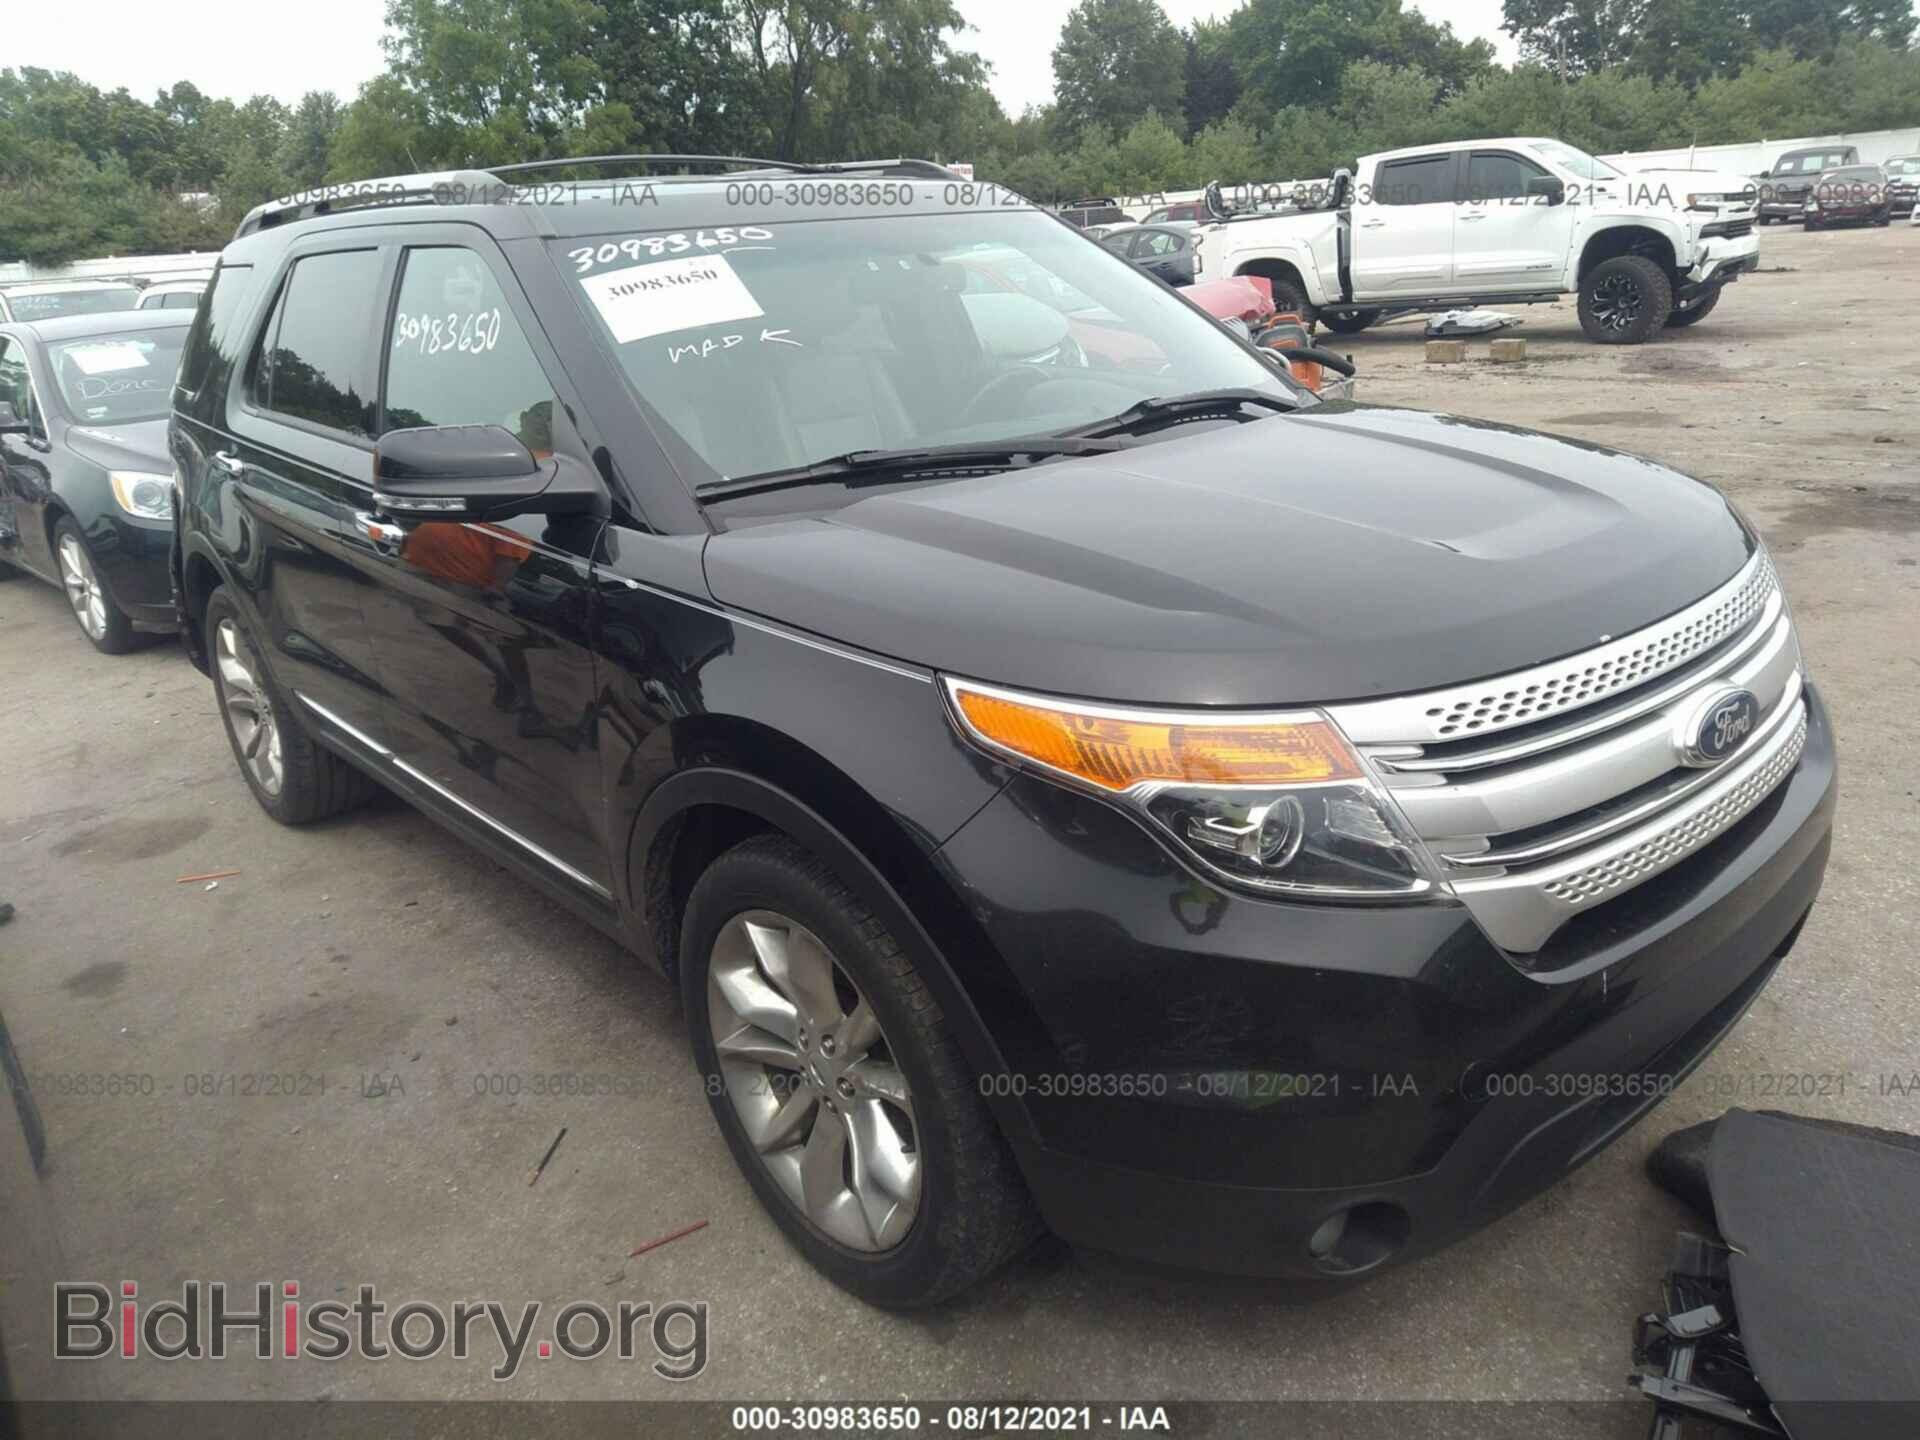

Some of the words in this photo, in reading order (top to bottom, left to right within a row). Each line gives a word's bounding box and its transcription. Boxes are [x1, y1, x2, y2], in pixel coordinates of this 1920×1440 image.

[607, 268, 718, 300] 30983650
[395, 307, 501, 354] 30983650
[1714, 701, 1751, 750] Ford
